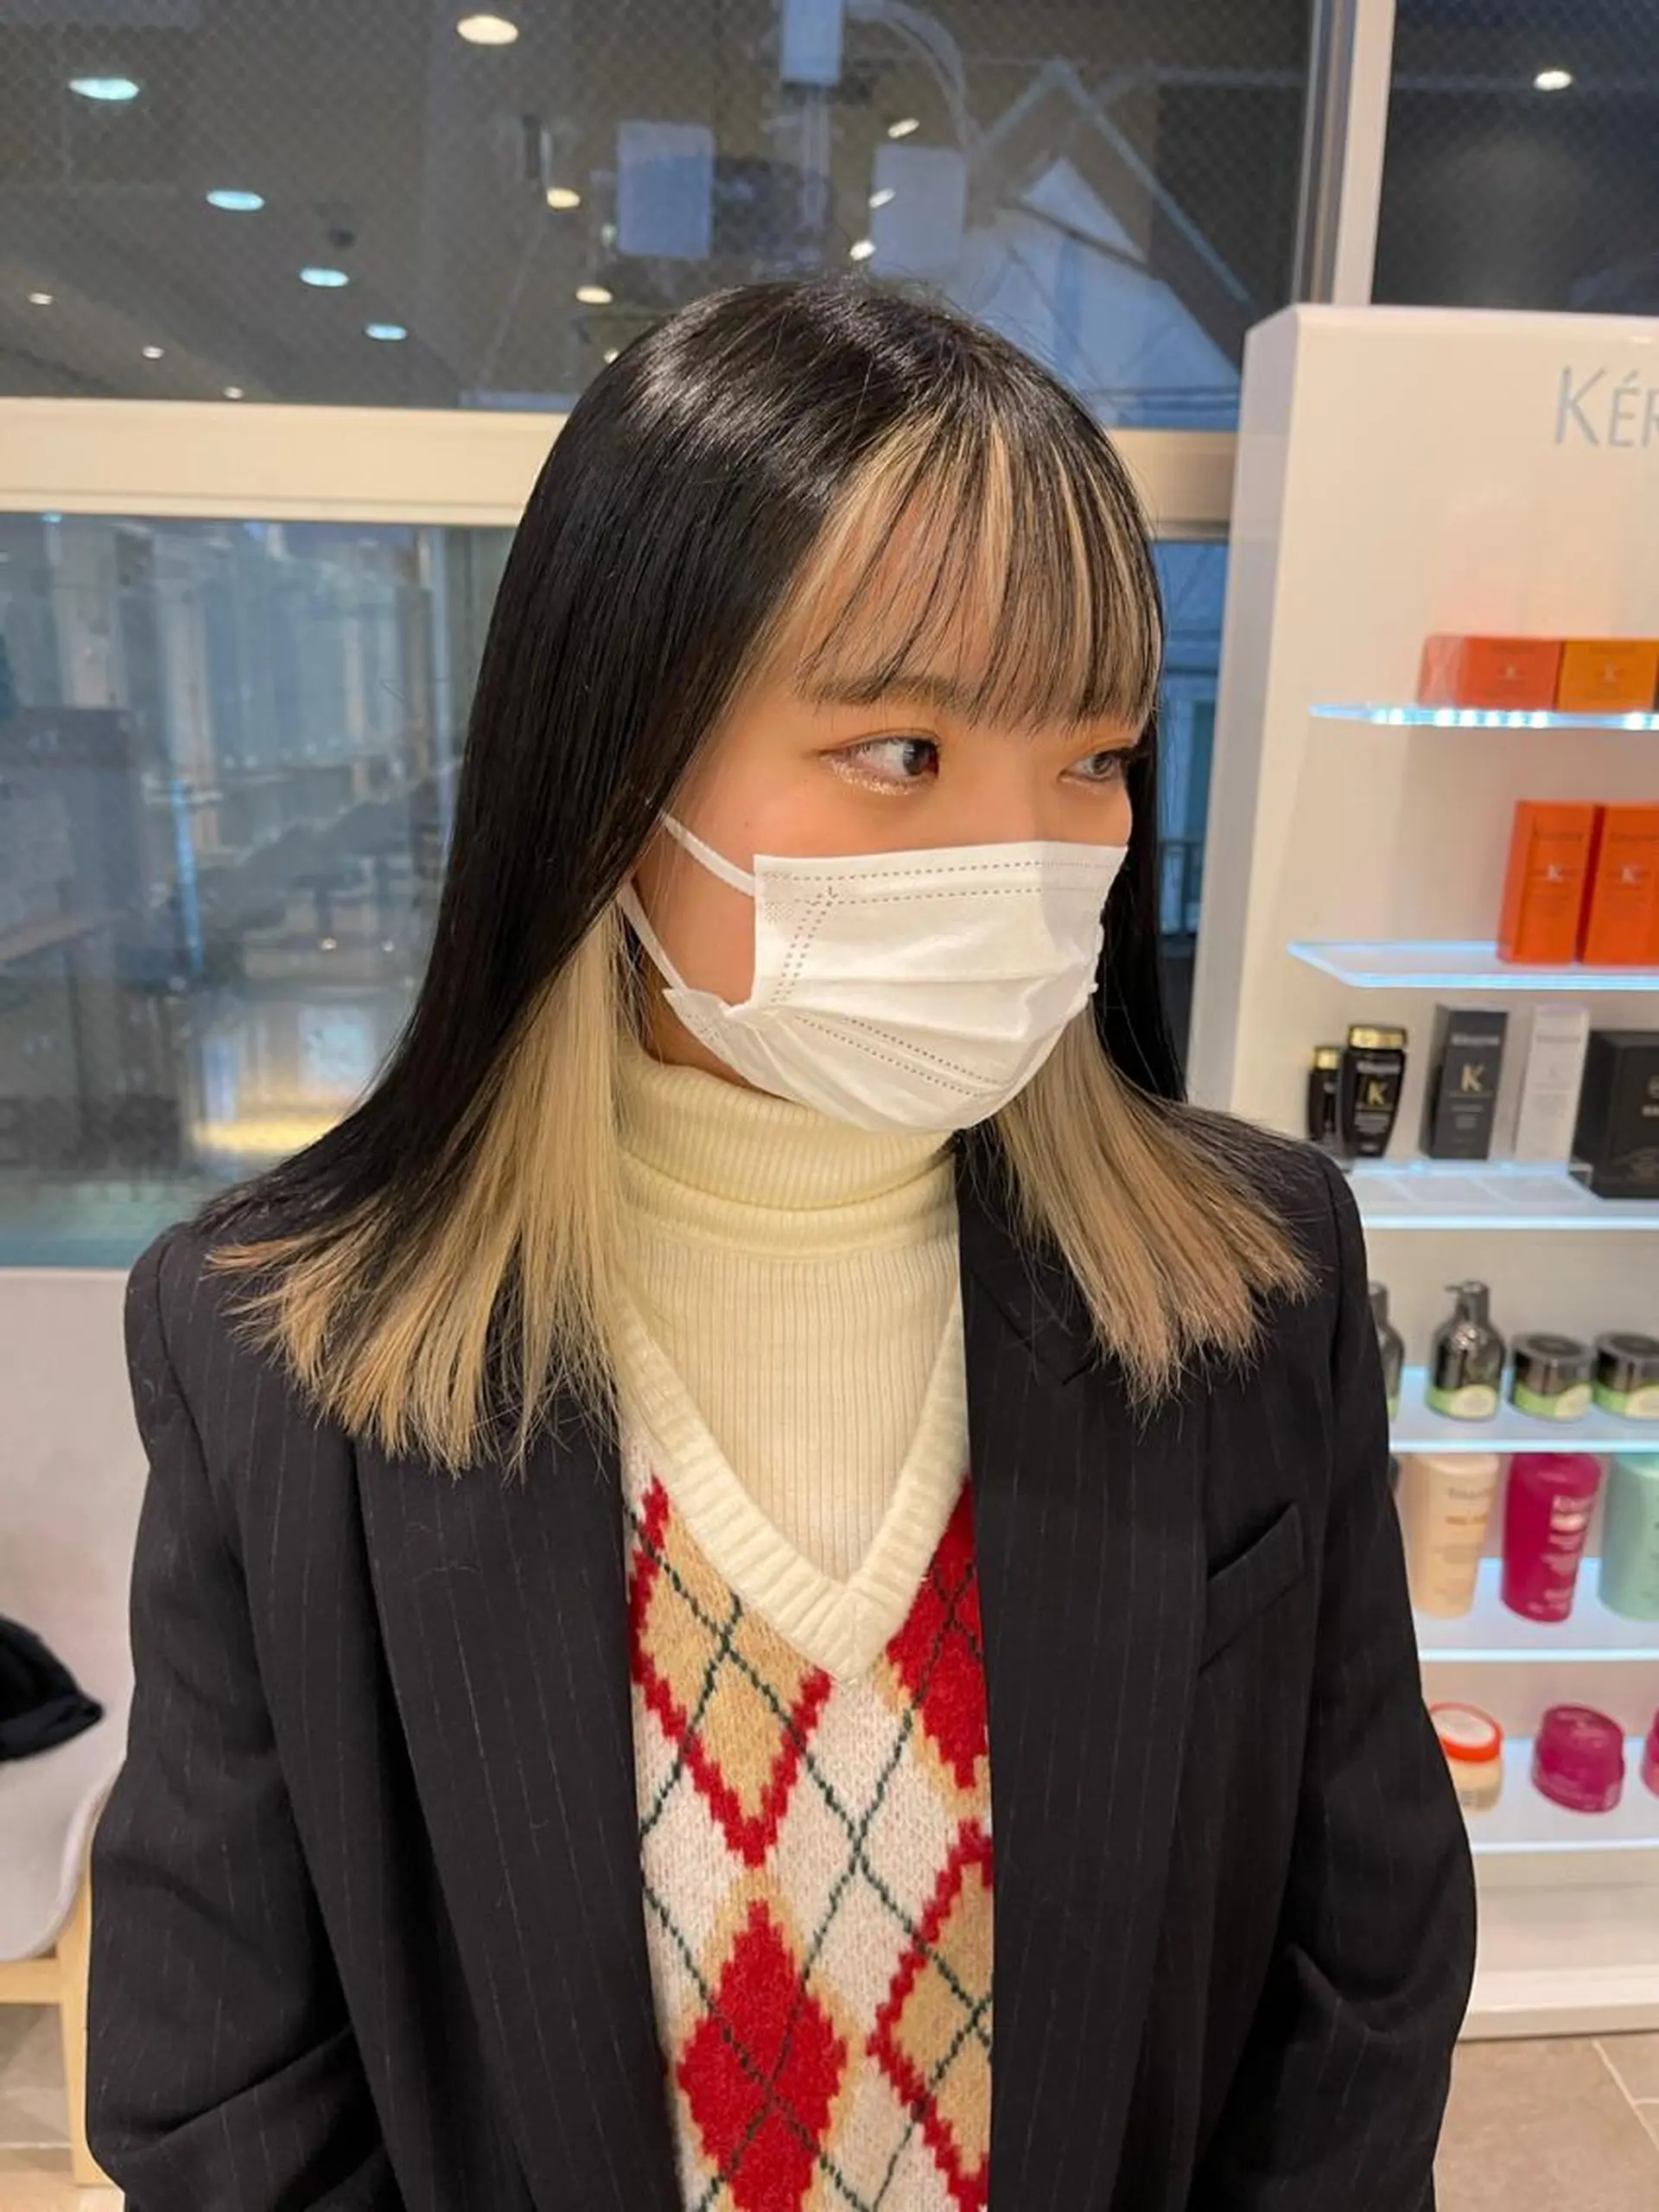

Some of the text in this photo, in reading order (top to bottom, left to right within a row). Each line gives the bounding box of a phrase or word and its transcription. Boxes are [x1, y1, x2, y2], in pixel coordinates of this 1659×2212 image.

[1547, 863, 1562, 881] K
[1621, 863, 1640, 883] K
[1460, 1064, 1484, 1093] K
[1368, 1080, 1389, 1105] K
